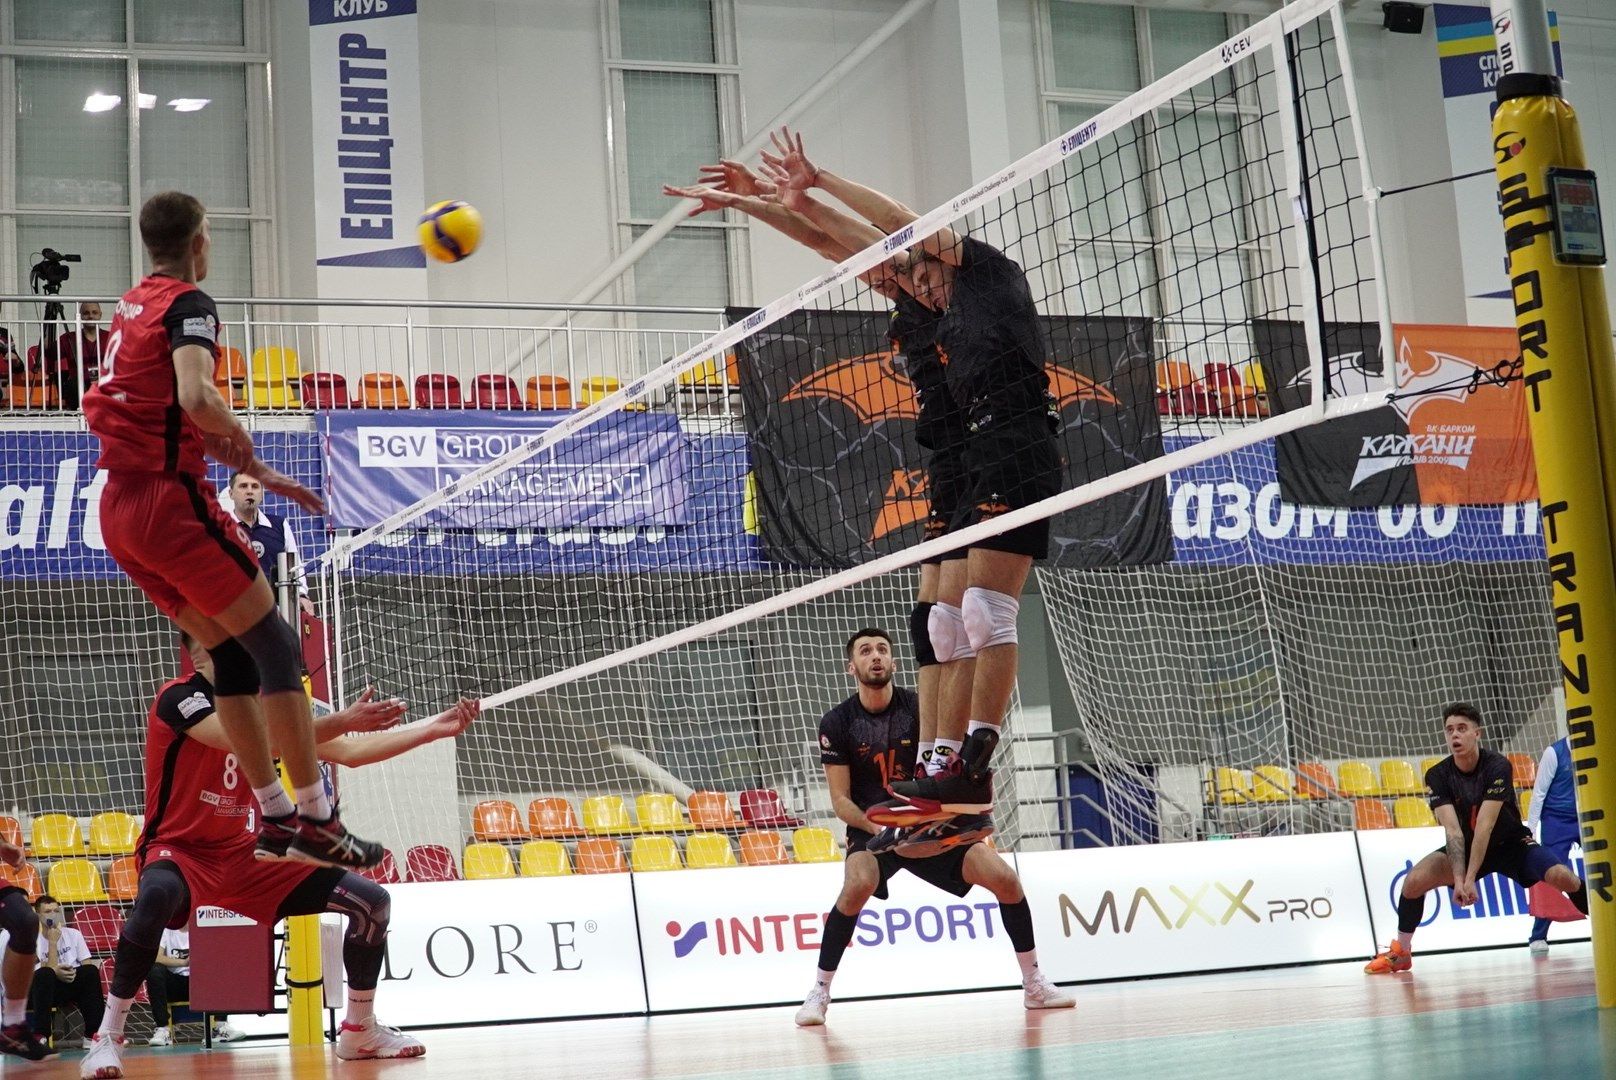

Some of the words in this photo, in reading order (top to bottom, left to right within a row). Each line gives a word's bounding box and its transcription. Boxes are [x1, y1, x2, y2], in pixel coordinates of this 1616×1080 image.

[1233, 36, 1251, 54] CEV
[338, 33, 394, 239] ЕПІЦЕНТР
[367, 435, 427, 457] BGV
[1543, 501, 1613, 903] TRANSFER
[223, 753, 238, 790] 8
[715, 902, 999, 956] INTESPORT
[1058, 878, 1262, 938] MAXX
[1267, 896, 1333, 923] PRO
[380, 920, 584, 981] LORE
